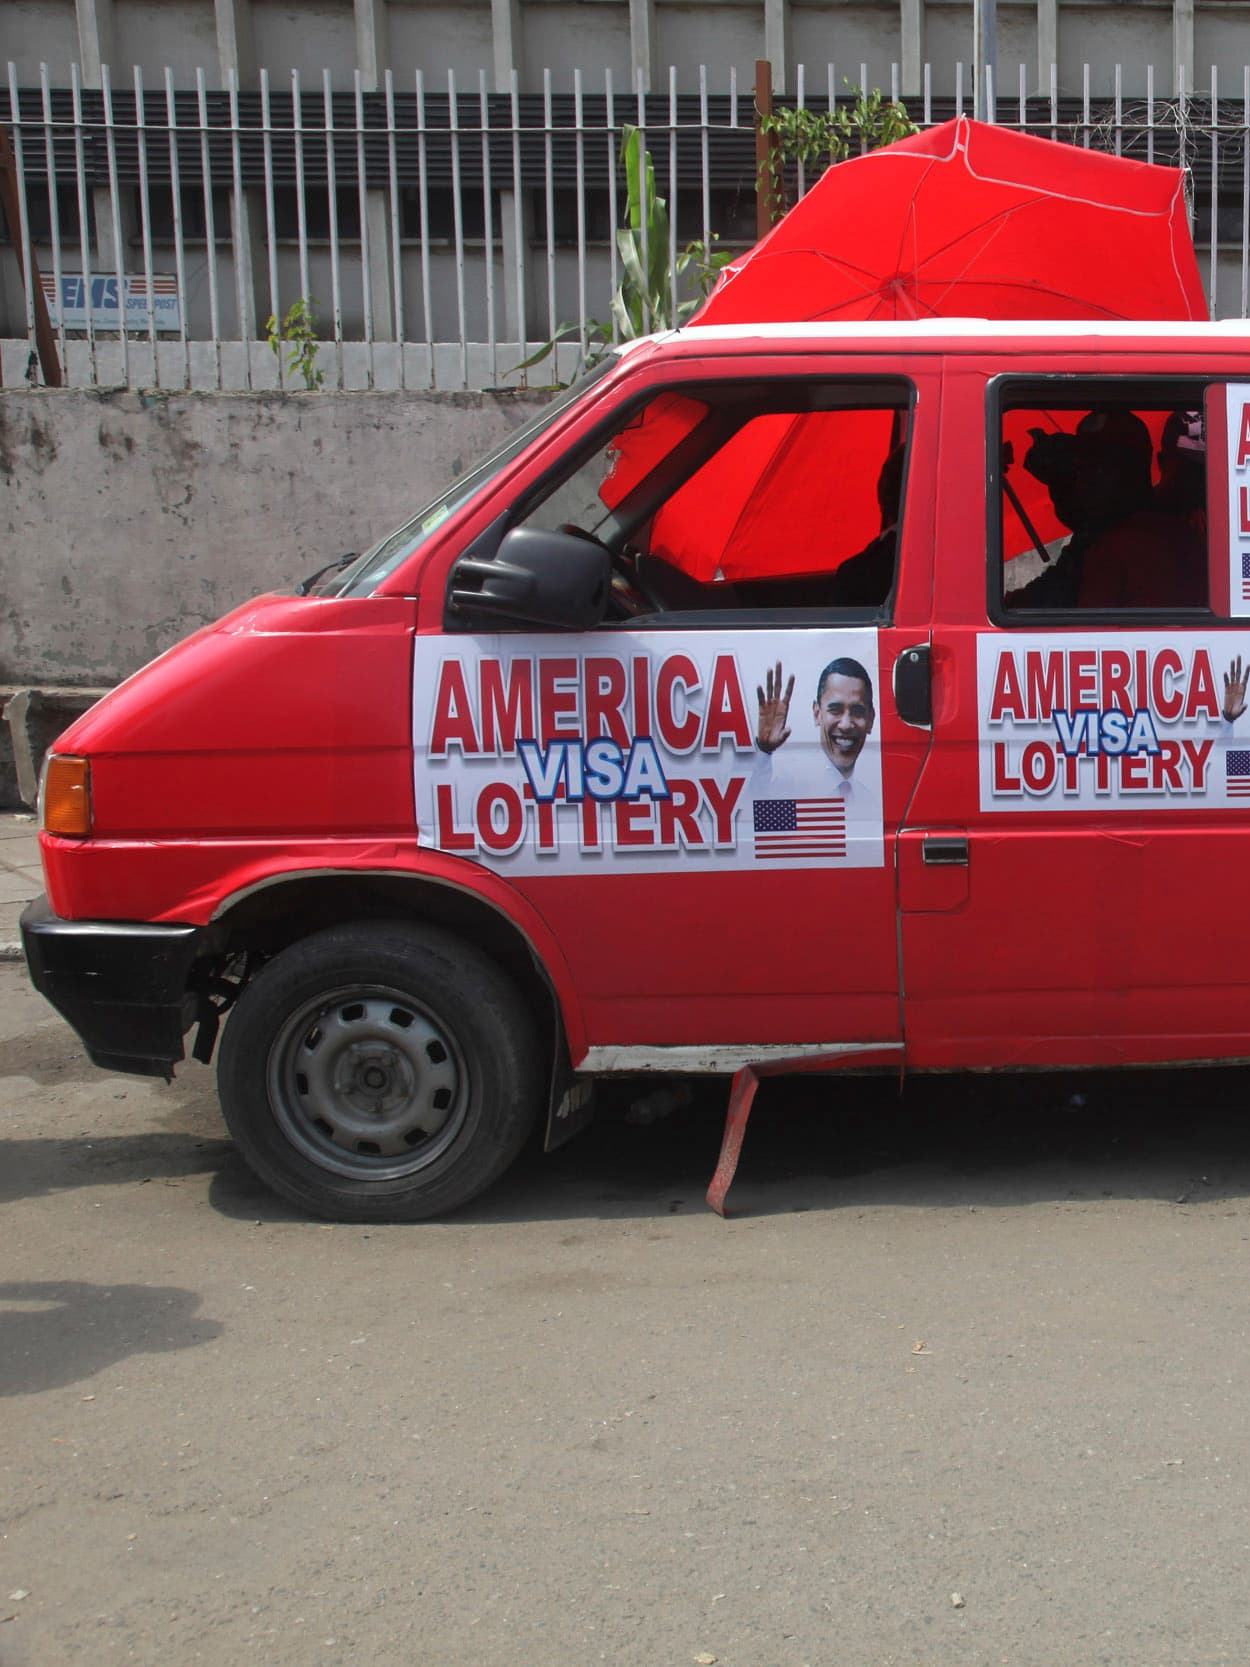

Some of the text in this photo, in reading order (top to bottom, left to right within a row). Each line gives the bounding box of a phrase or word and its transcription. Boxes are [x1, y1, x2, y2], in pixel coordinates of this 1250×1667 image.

[60, 278, 128, 309] EMS
[429, 654, 753, 754] AMERICA
[990, 648, 1220, 720] AMERICA
[994, 739, 1215, 791] LOTTERY
[1053, 708, 1160, 757] VISA
[516, 736, 670, 803] VISA
[436, 776, 747, 850] LOTTERY
